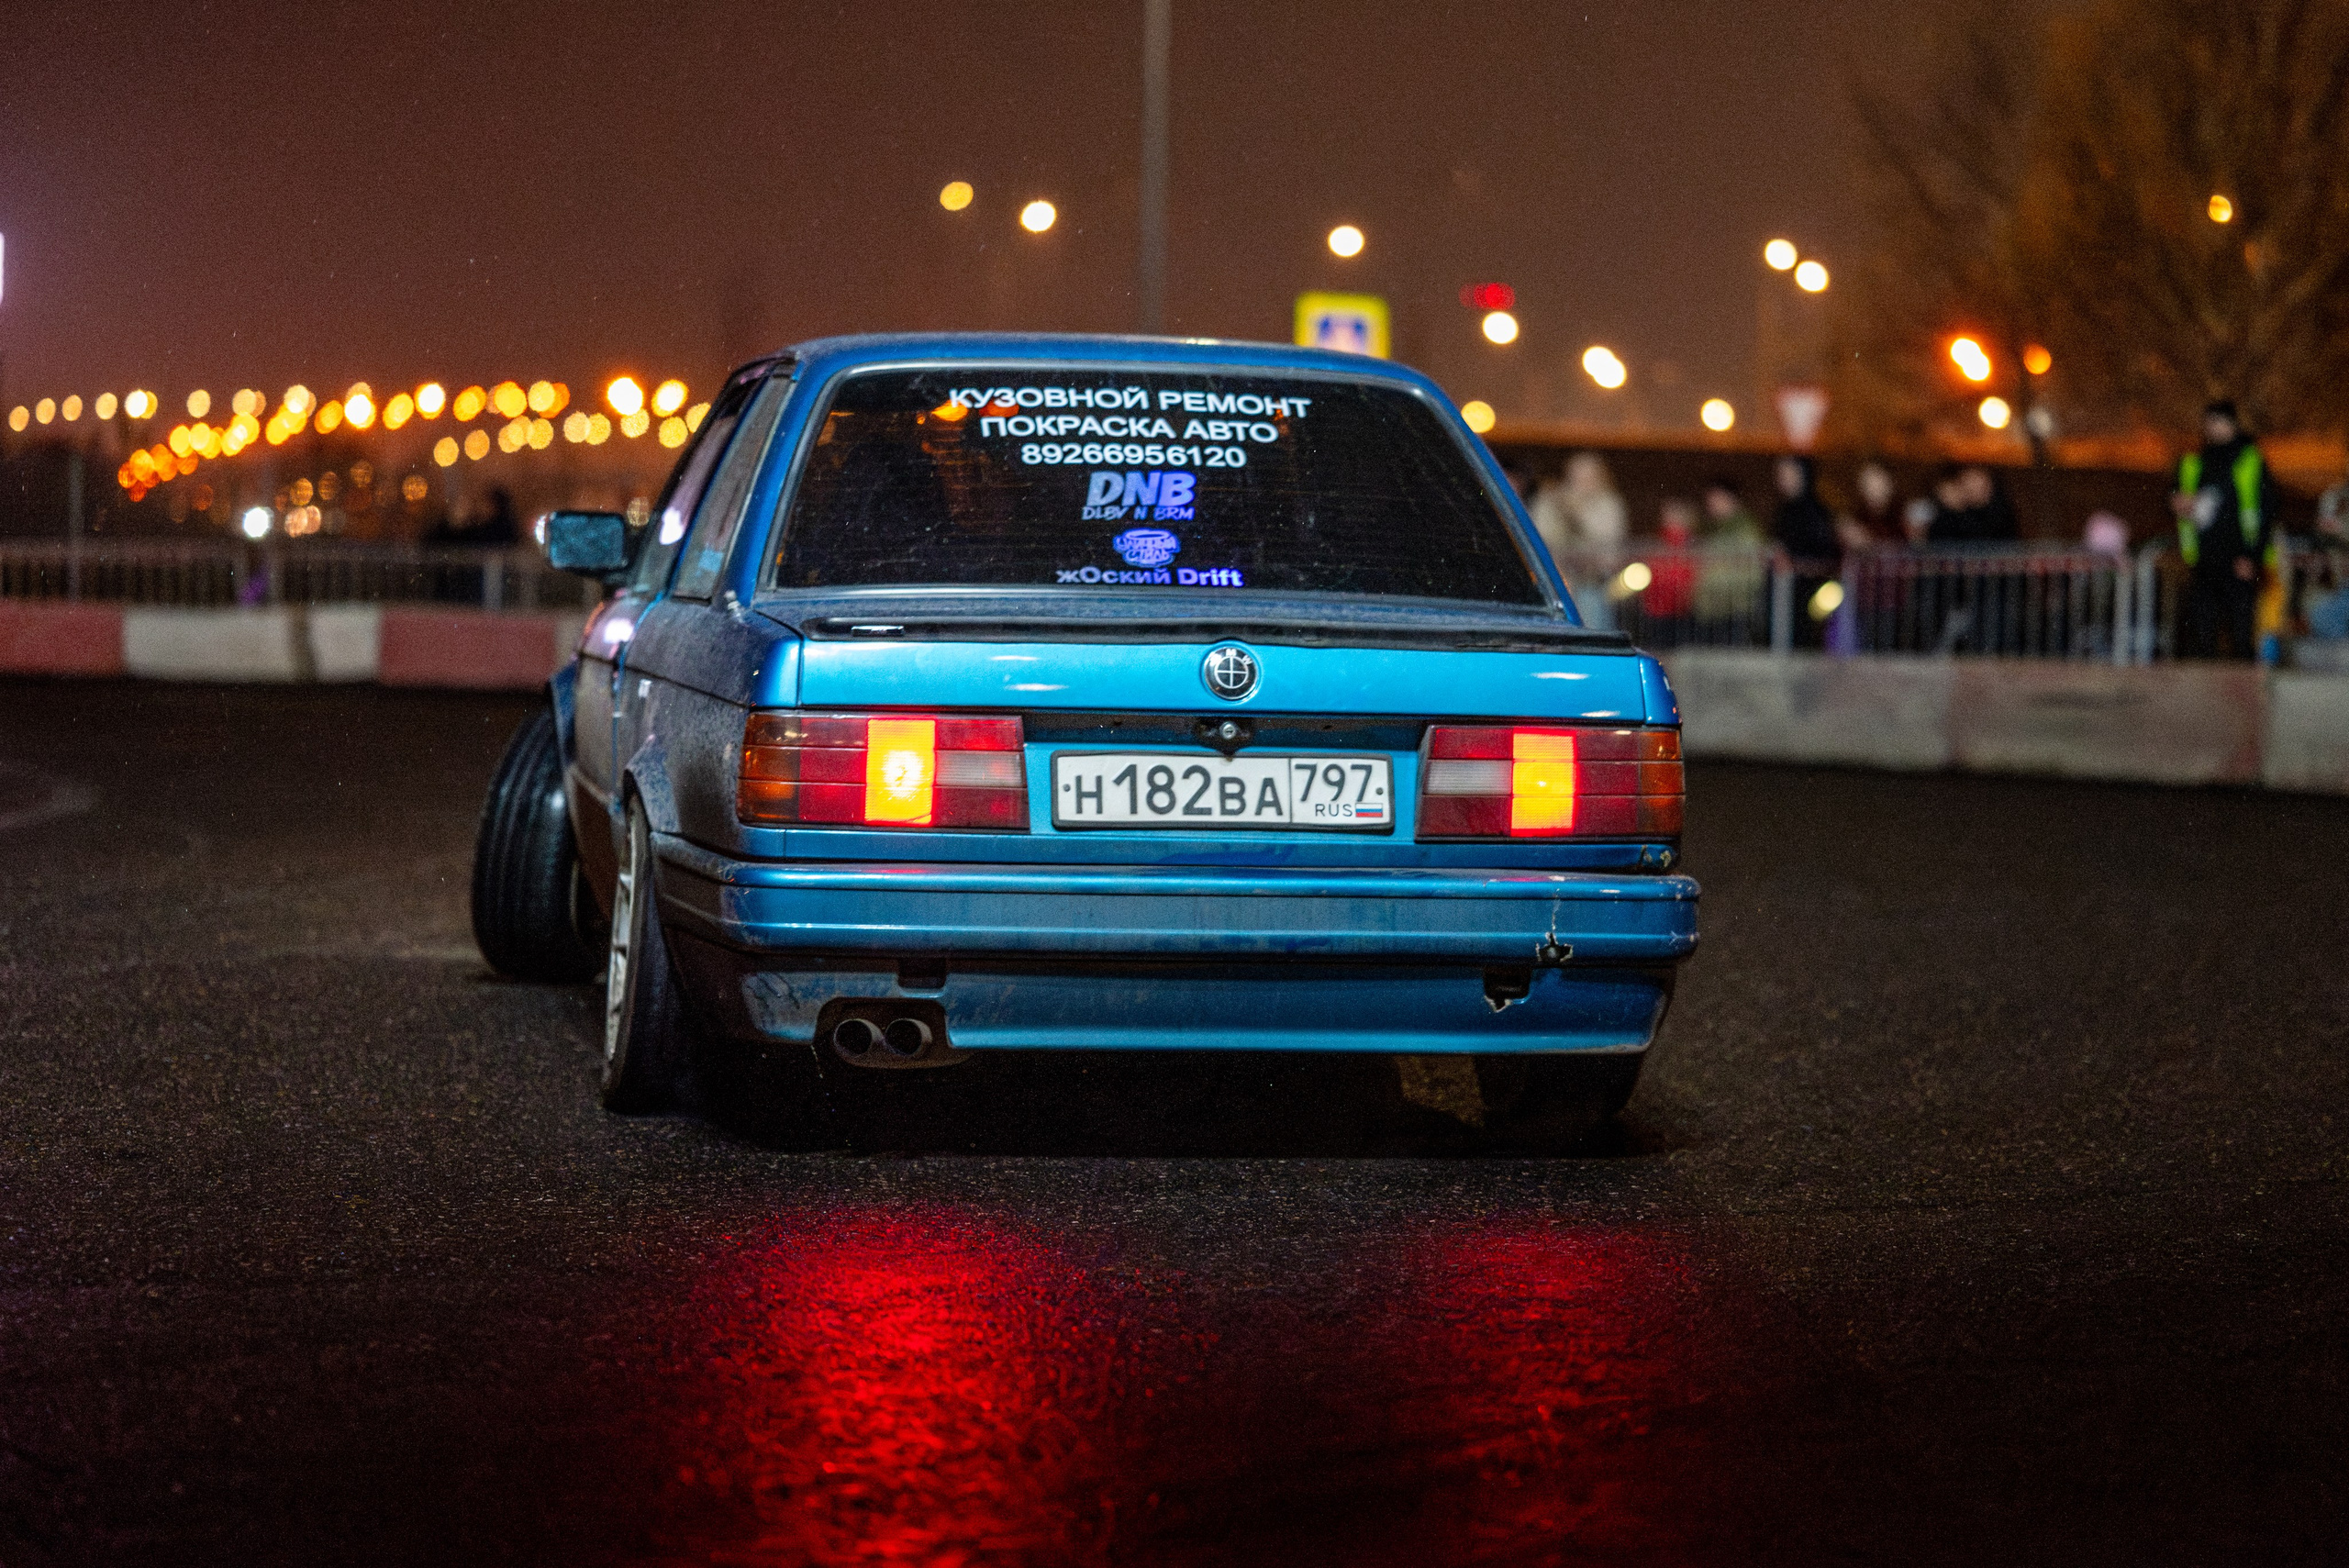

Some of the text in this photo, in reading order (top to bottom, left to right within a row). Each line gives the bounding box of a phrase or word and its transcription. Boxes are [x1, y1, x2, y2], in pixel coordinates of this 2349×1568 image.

[949, 385, 1312, 418] КУЗОВНОЙ РЕМОНТ
[980, 415, 1279, 444] ПОКРАСКА АВТО
[1020, 442, 1247, 468] 89266956120
[1086, 470, 1197, 507] DNB
[1056, 565, 1243, 587] жОский Drift
[1074, 763, 1373, 817] Н182ВА 797
[1315, 803, 1353, 817] RUS
